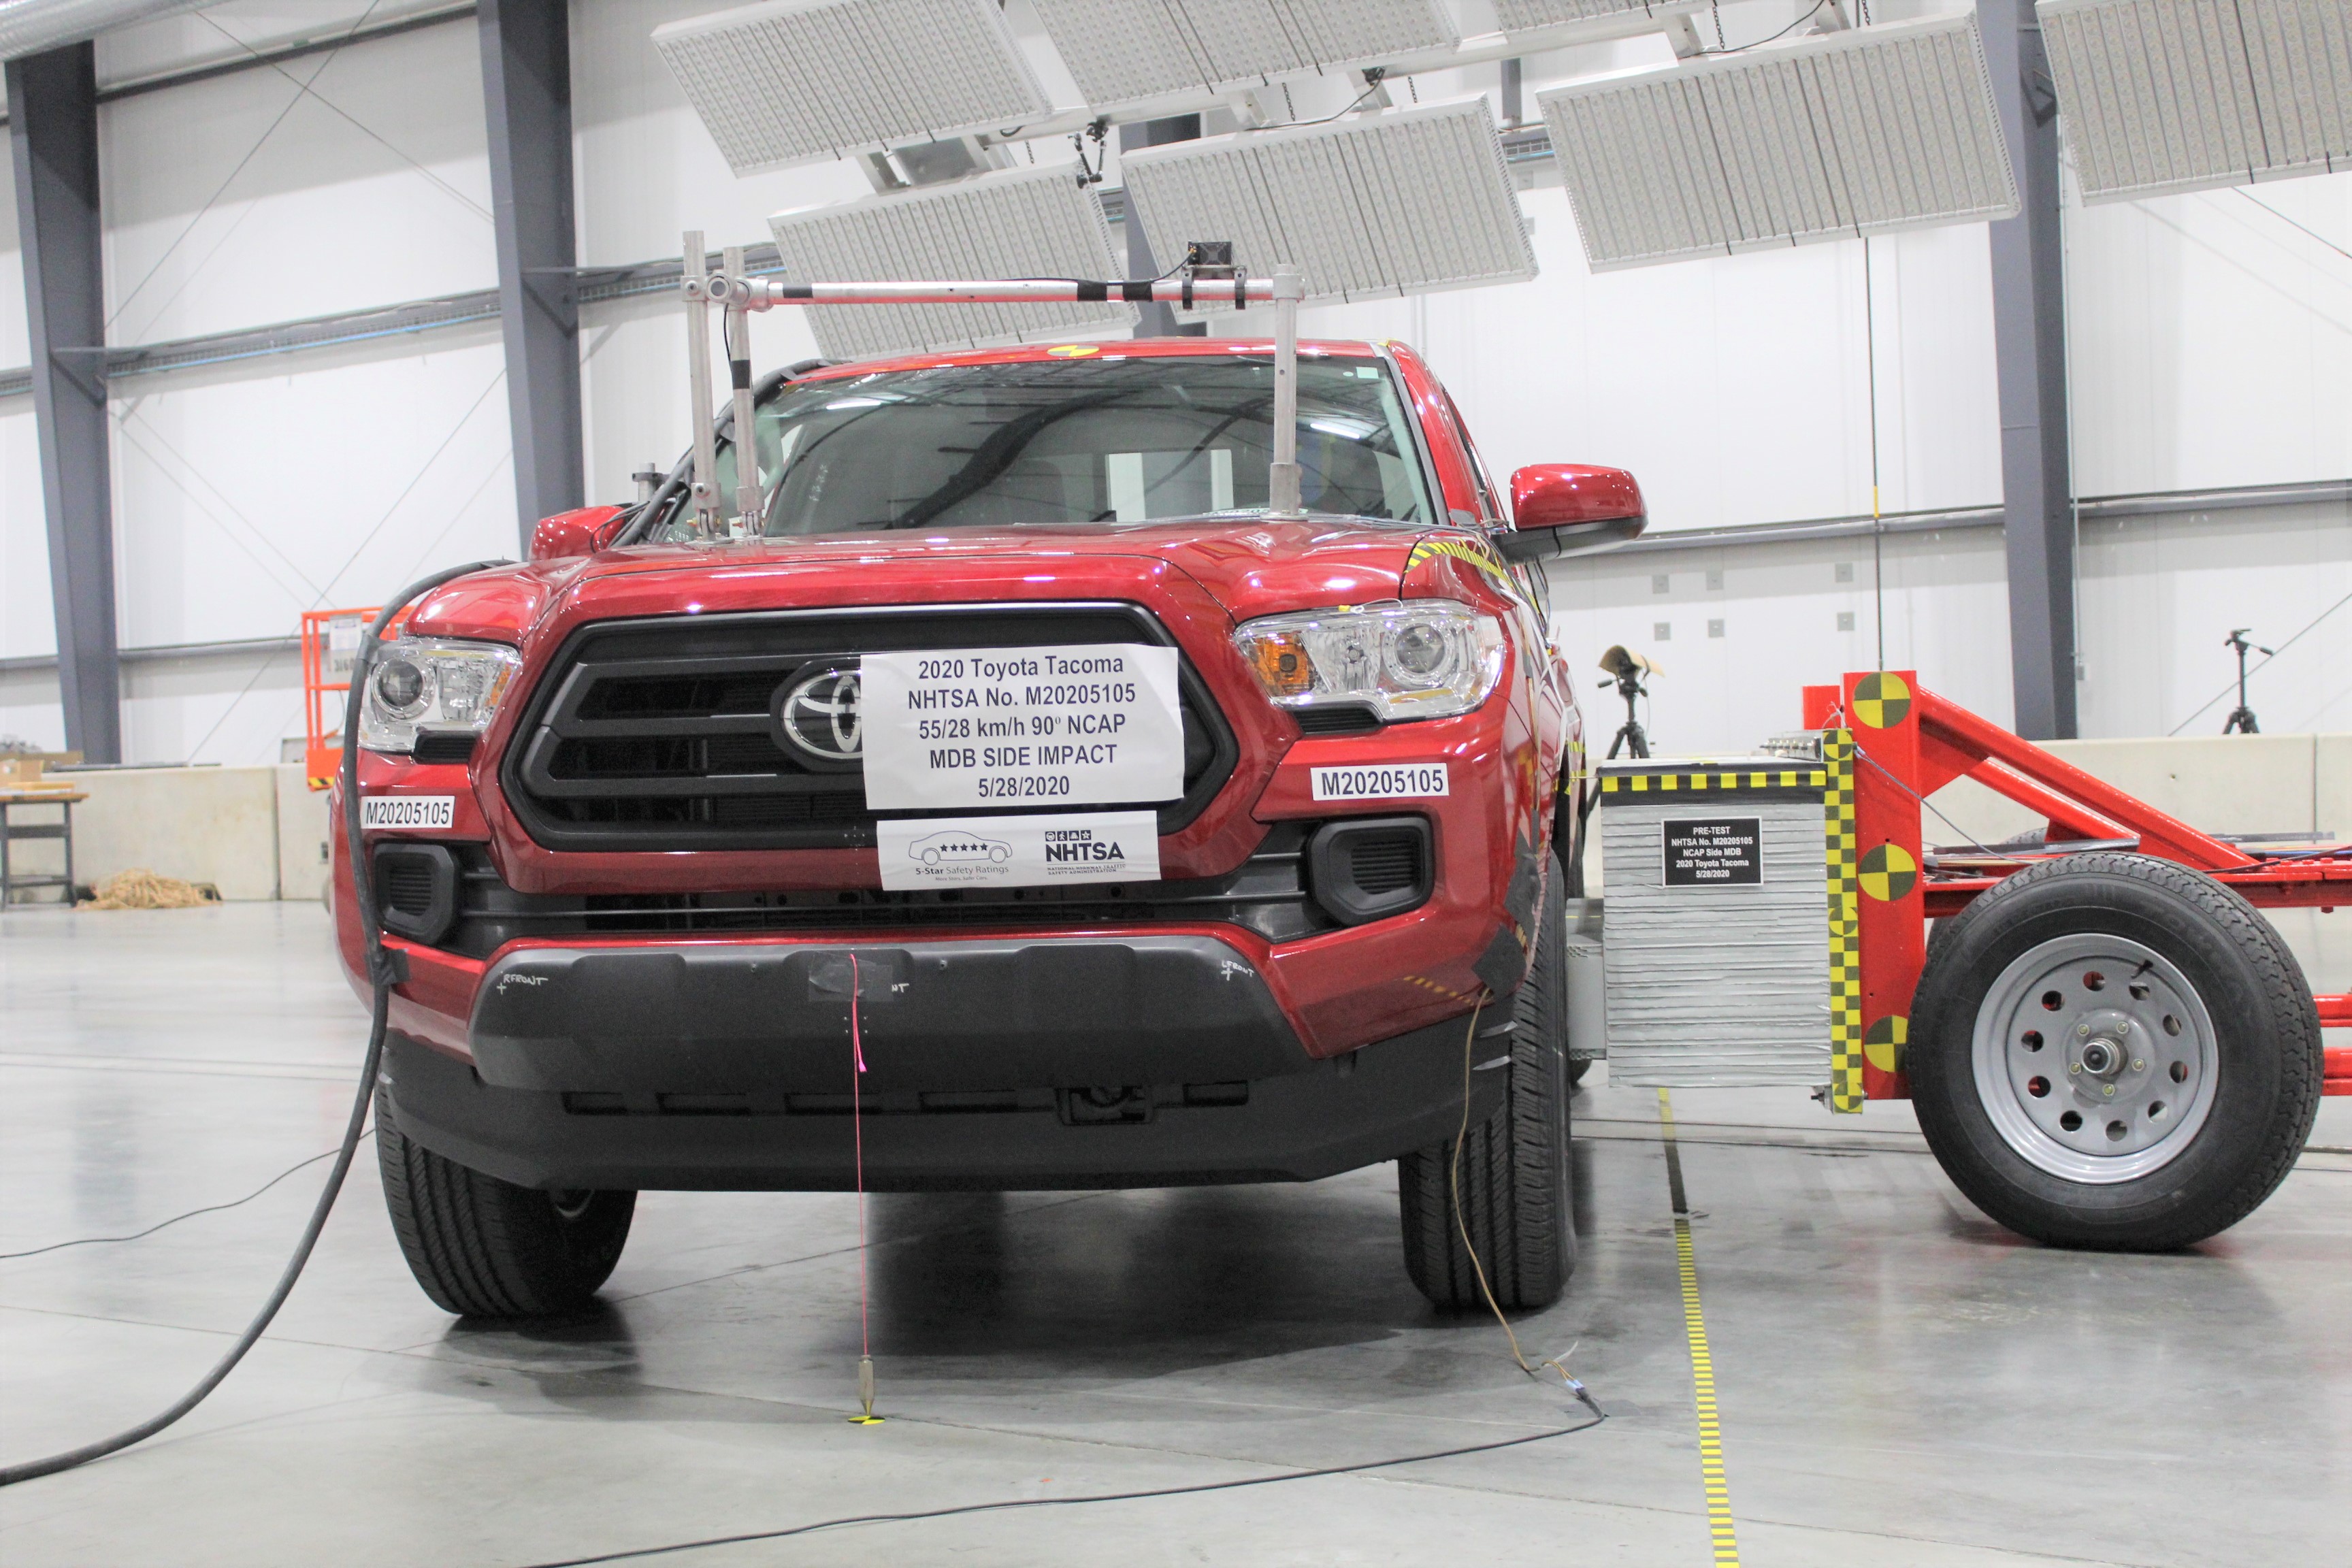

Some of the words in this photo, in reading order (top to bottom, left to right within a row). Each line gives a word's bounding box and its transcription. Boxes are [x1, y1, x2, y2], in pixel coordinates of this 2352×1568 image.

[919, 659, 964, 679] 2020
[971, 657, 1039, 681] Toyota
[1045, 655, 1124, 675] Tacoma
[908, 689, 979, 709] NHTSA
[986, 687, 1018, 707] No.
[1026, 683, 1136, 705] M20205105
[919, 719, 970, 739] 55/28
[977, 717, 1025, 737] km/h
[1067, 713, 1126, 734] NCAP
[930, 749, 976, 768] MDB
[983, 747, 1031, 767] SIDE
[1038, 744, 1117, 765] IMPACT
[978, 776, 1070, 797] 5/28/2020
[1322, 769, 1443, 796] M20205105
[366, 802, 450, 824] M20205105
[1671, 838, 1697, 846] NHTSA
[1712, 836, 1753, 845] M20205105
[1693, 826, 1731, 835] PRE-TEST
[1045, 841, 1125, 862] NHTSA
[1683, 849, 1704, 857] NCAP
[1705, 848, 1722, 856] Side
[1724, 847, 1742, 855] MDB
[915, 867, 944, 875] 5-Star
[946, 866, 973, 876] Safety
[975, 865, 1009, 875] Ratings
[1676, 860, 1693, 868] 2020
[1695, 859, 1719, 868] Toyota
[1720, 858, 1749, 866] Tacoma
[1696, 870, 1730, 878] 5/28/2020
[503, 973, 549, 985] RFRONT
